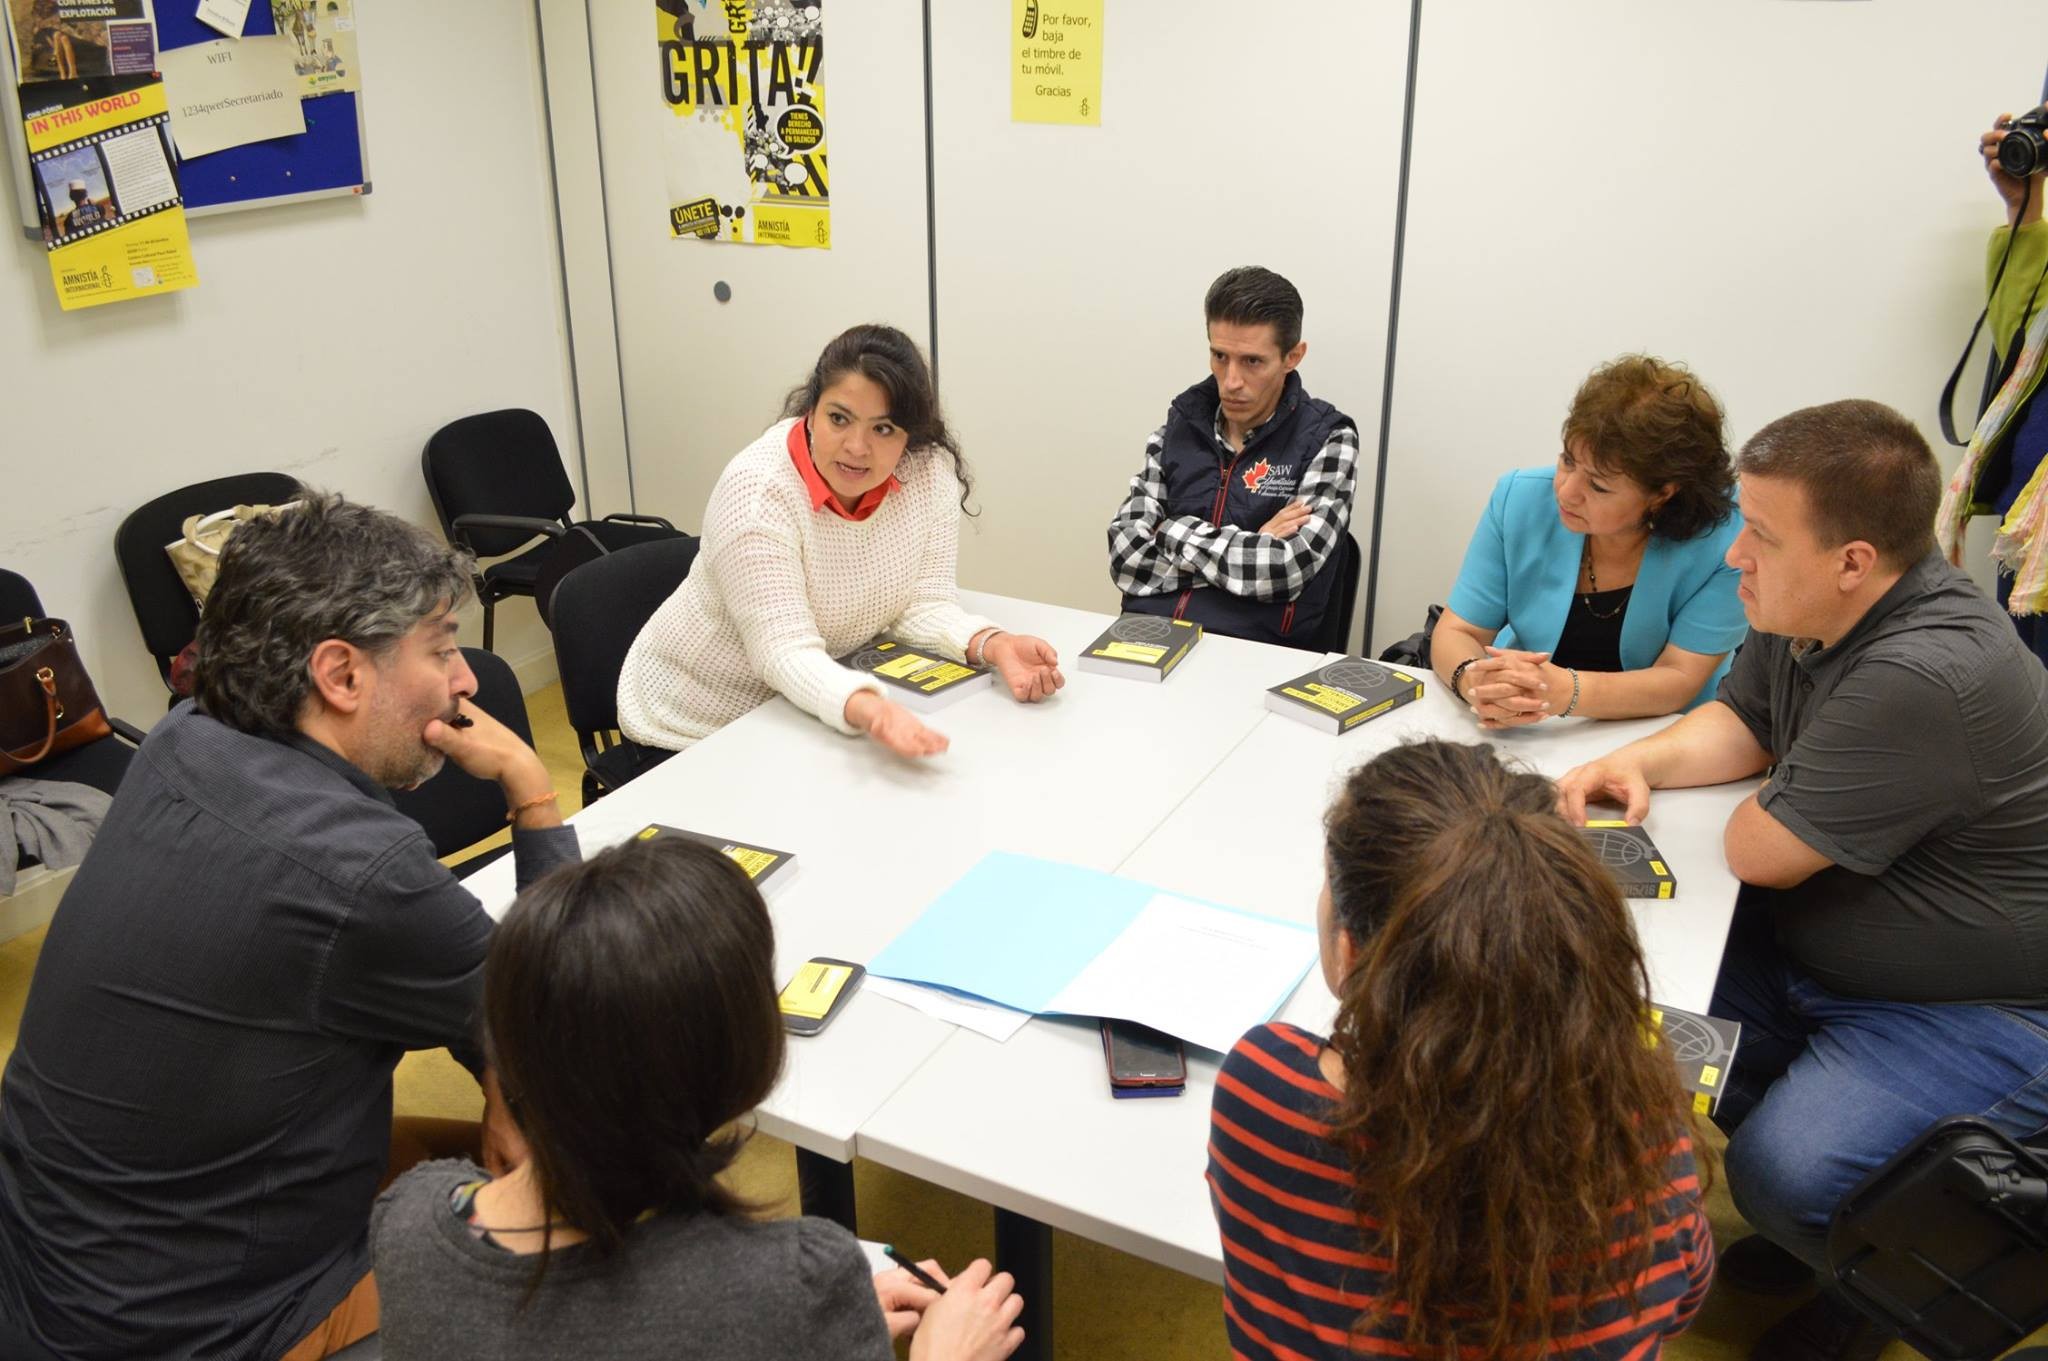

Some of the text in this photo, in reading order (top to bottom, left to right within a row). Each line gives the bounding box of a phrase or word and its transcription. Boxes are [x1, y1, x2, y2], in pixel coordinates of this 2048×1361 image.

[58, 7, 117, 18] EXPLOTACIÓN
[1042, 14, 1092, 28] Por favor,
[1042, 31, 1064, 44] baja
[206, 51, 233, 65] WIFI
[1021, 48, 1082, 60] el timbre de
[661, 35, 823, 107] GRITA!!
[1021, 63, 1064, 76] tu móvil.
[1035, 85, 1072, 97] Gracias
[181, 89, 284, 119] 1234qwerSecretariado
[31, 91, 141, 134] IN THIS WORLD
[790, 112, 809, 120] TIENES
[788, 120, 812, 128] DERECHO
[786, 128, 820, 136] PERMANECER
[785, 135, 816, 144] EN SILENCIO
[674, 202, 714, 224] ÚNETE
[758, 218, 790, 232] AMNISTÍA
[62, 268, 99, 286] AMNISTÍA
[1269, 465, 1293, 476] SAW
